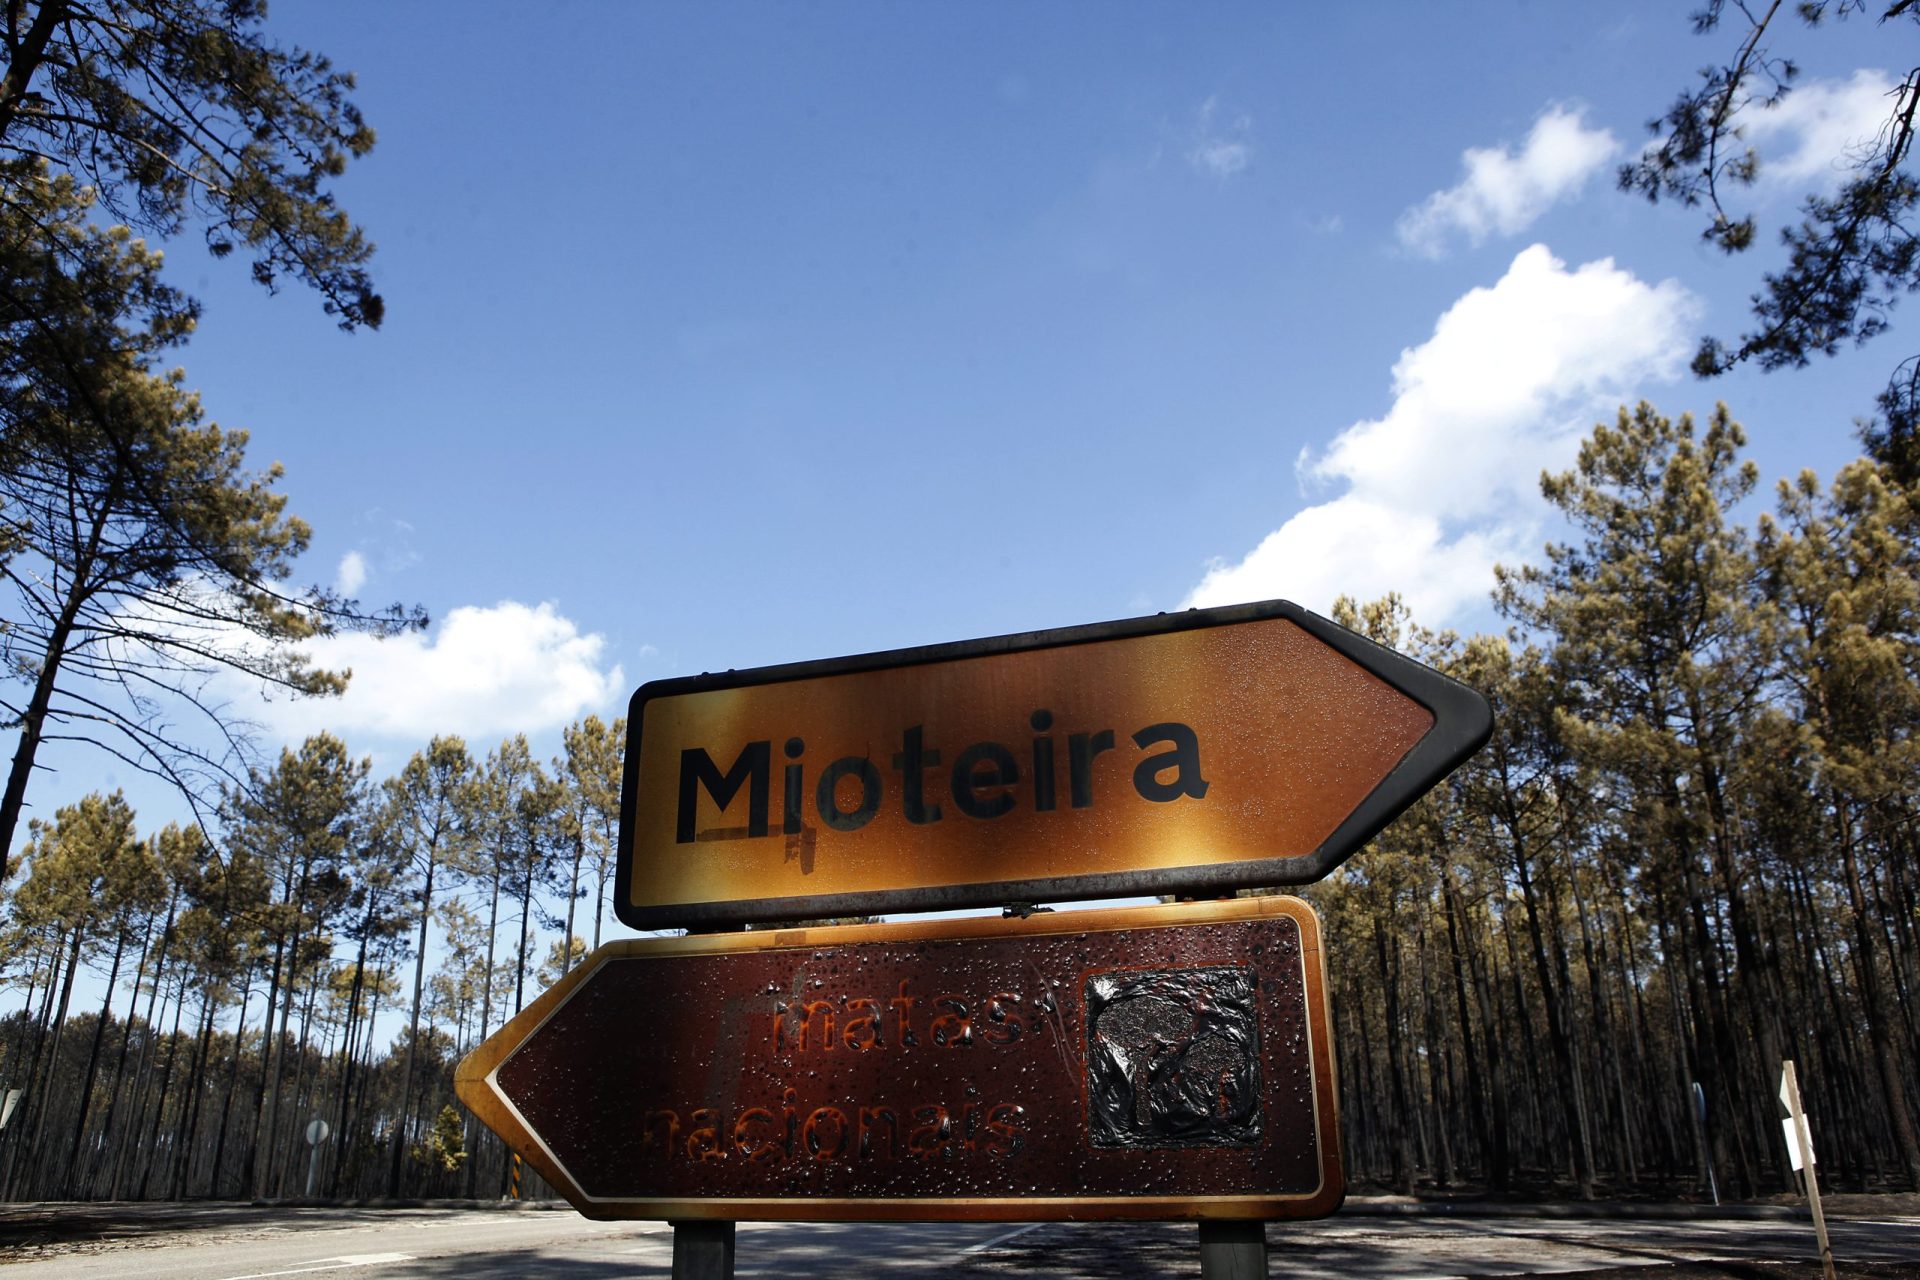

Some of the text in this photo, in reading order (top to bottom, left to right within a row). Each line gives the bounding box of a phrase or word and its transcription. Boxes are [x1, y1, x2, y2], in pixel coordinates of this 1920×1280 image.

[676, 709, 1210, 844] Mioteira
[773, 981, 1022, 1052] matas
[643, 1087, 1027, 1163] nacionais
